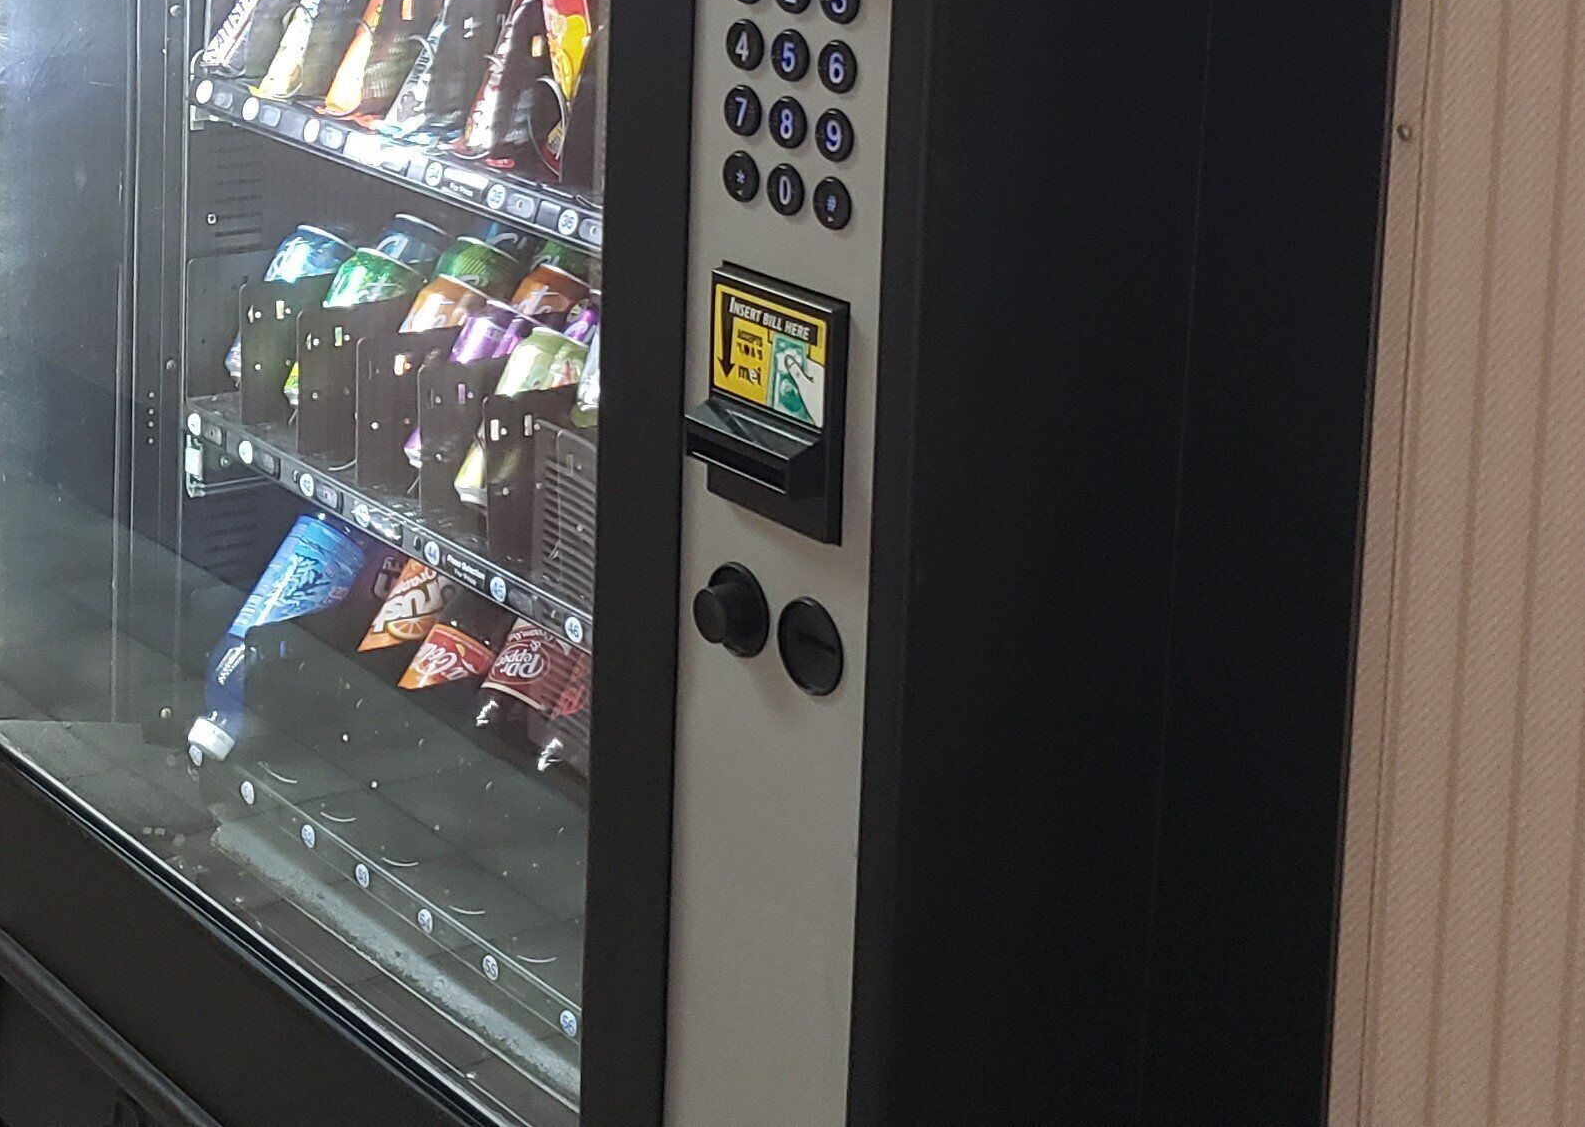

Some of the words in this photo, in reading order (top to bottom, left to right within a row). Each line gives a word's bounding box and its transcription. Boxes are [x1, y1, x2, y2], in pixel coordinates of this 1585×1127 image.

[735, 31, 750, 62] 4
[781, 42, 796, 73] 5
[828, 53, 844, 84] 6
[735, 97, 748, 127] 7
[779, 109, 794, 139] 8
[825, 121, 842, 153] 9
[779, 175, 792, 205] 0
[728, 296, 762, 323] INSERT
[762, 312, 783, 331] BILL
[783, 320, 811, 341] HERE
[738, 364, 762, 387] mei
